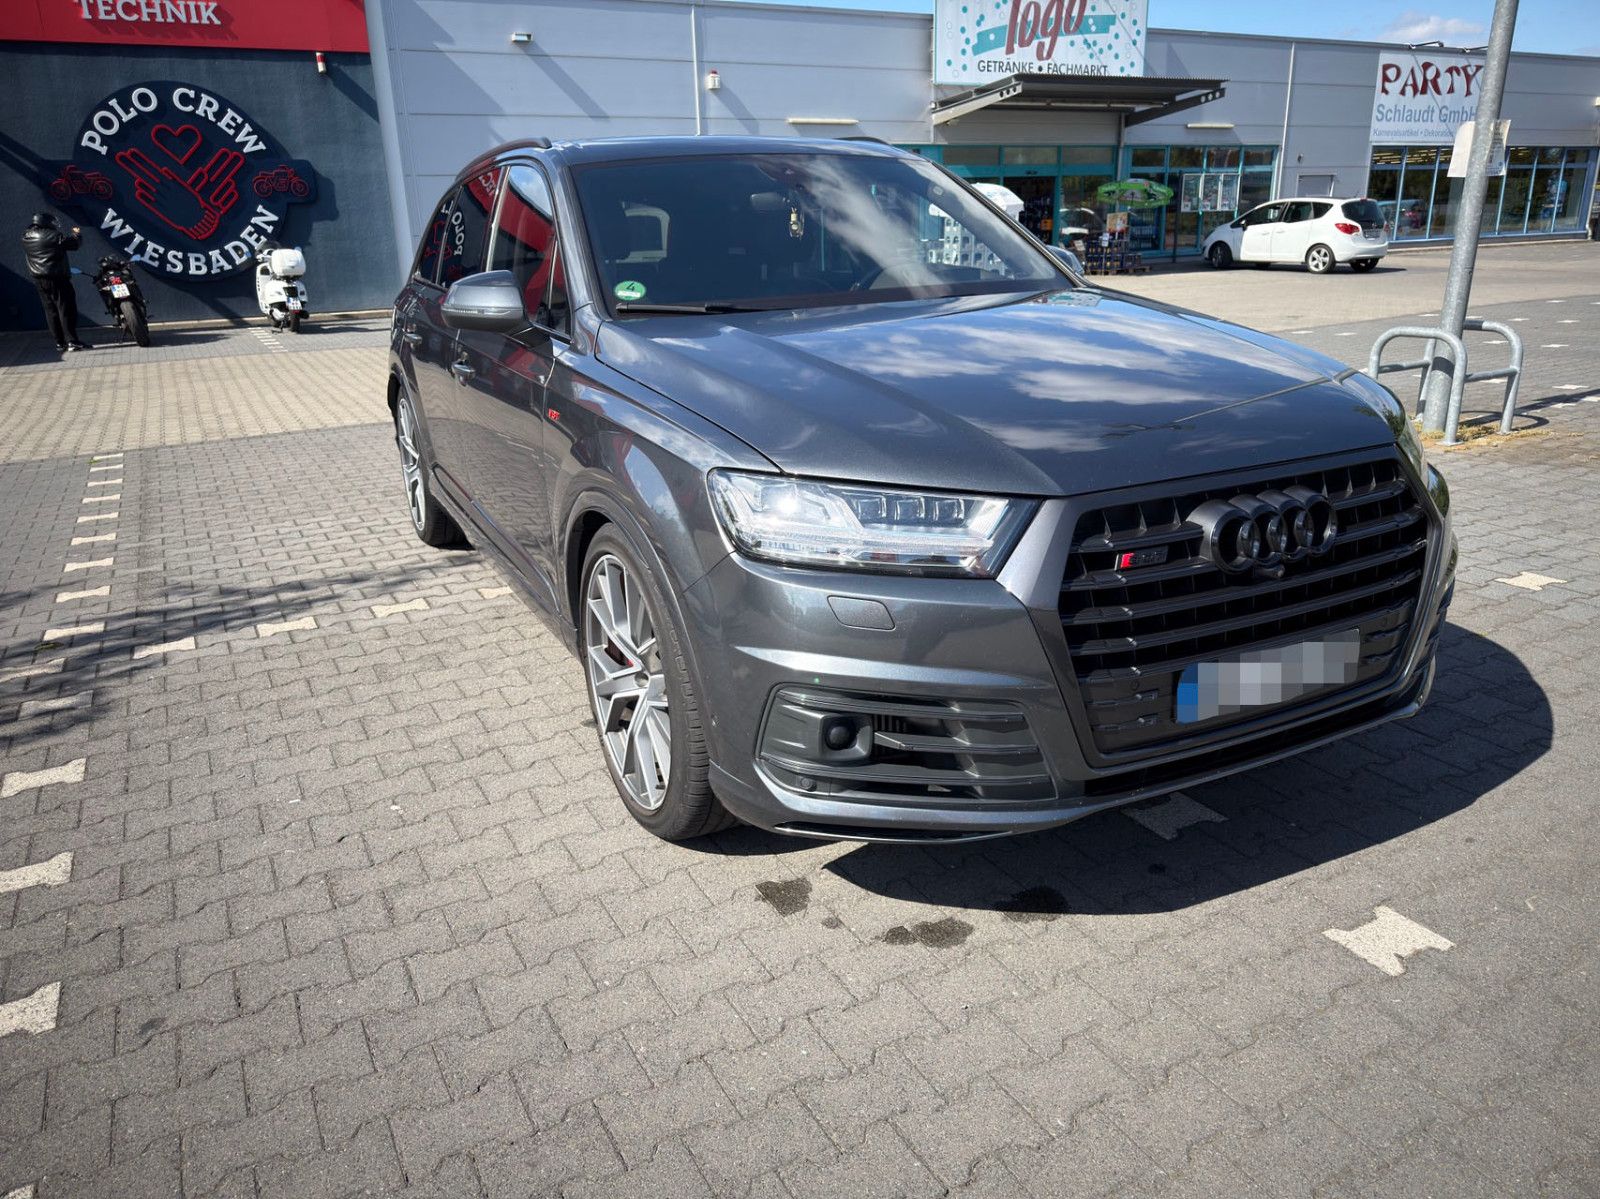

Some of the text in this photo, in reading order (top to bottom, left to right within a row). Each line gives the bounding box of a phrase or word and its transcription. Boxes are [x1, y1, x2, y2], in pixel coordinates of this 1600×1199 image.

[74, 0, 221, 25] TECHNIK
[977, 58, 1109, 76] GETRÄNKE FACHMARKT
[1380, 61, 1484, 97] PARTY
[81, 87, 266, 155] POLO CREW
[1375, 103, 1435, 123] Schlaudt
[100, 204, 279, 275] WIESBADEN
